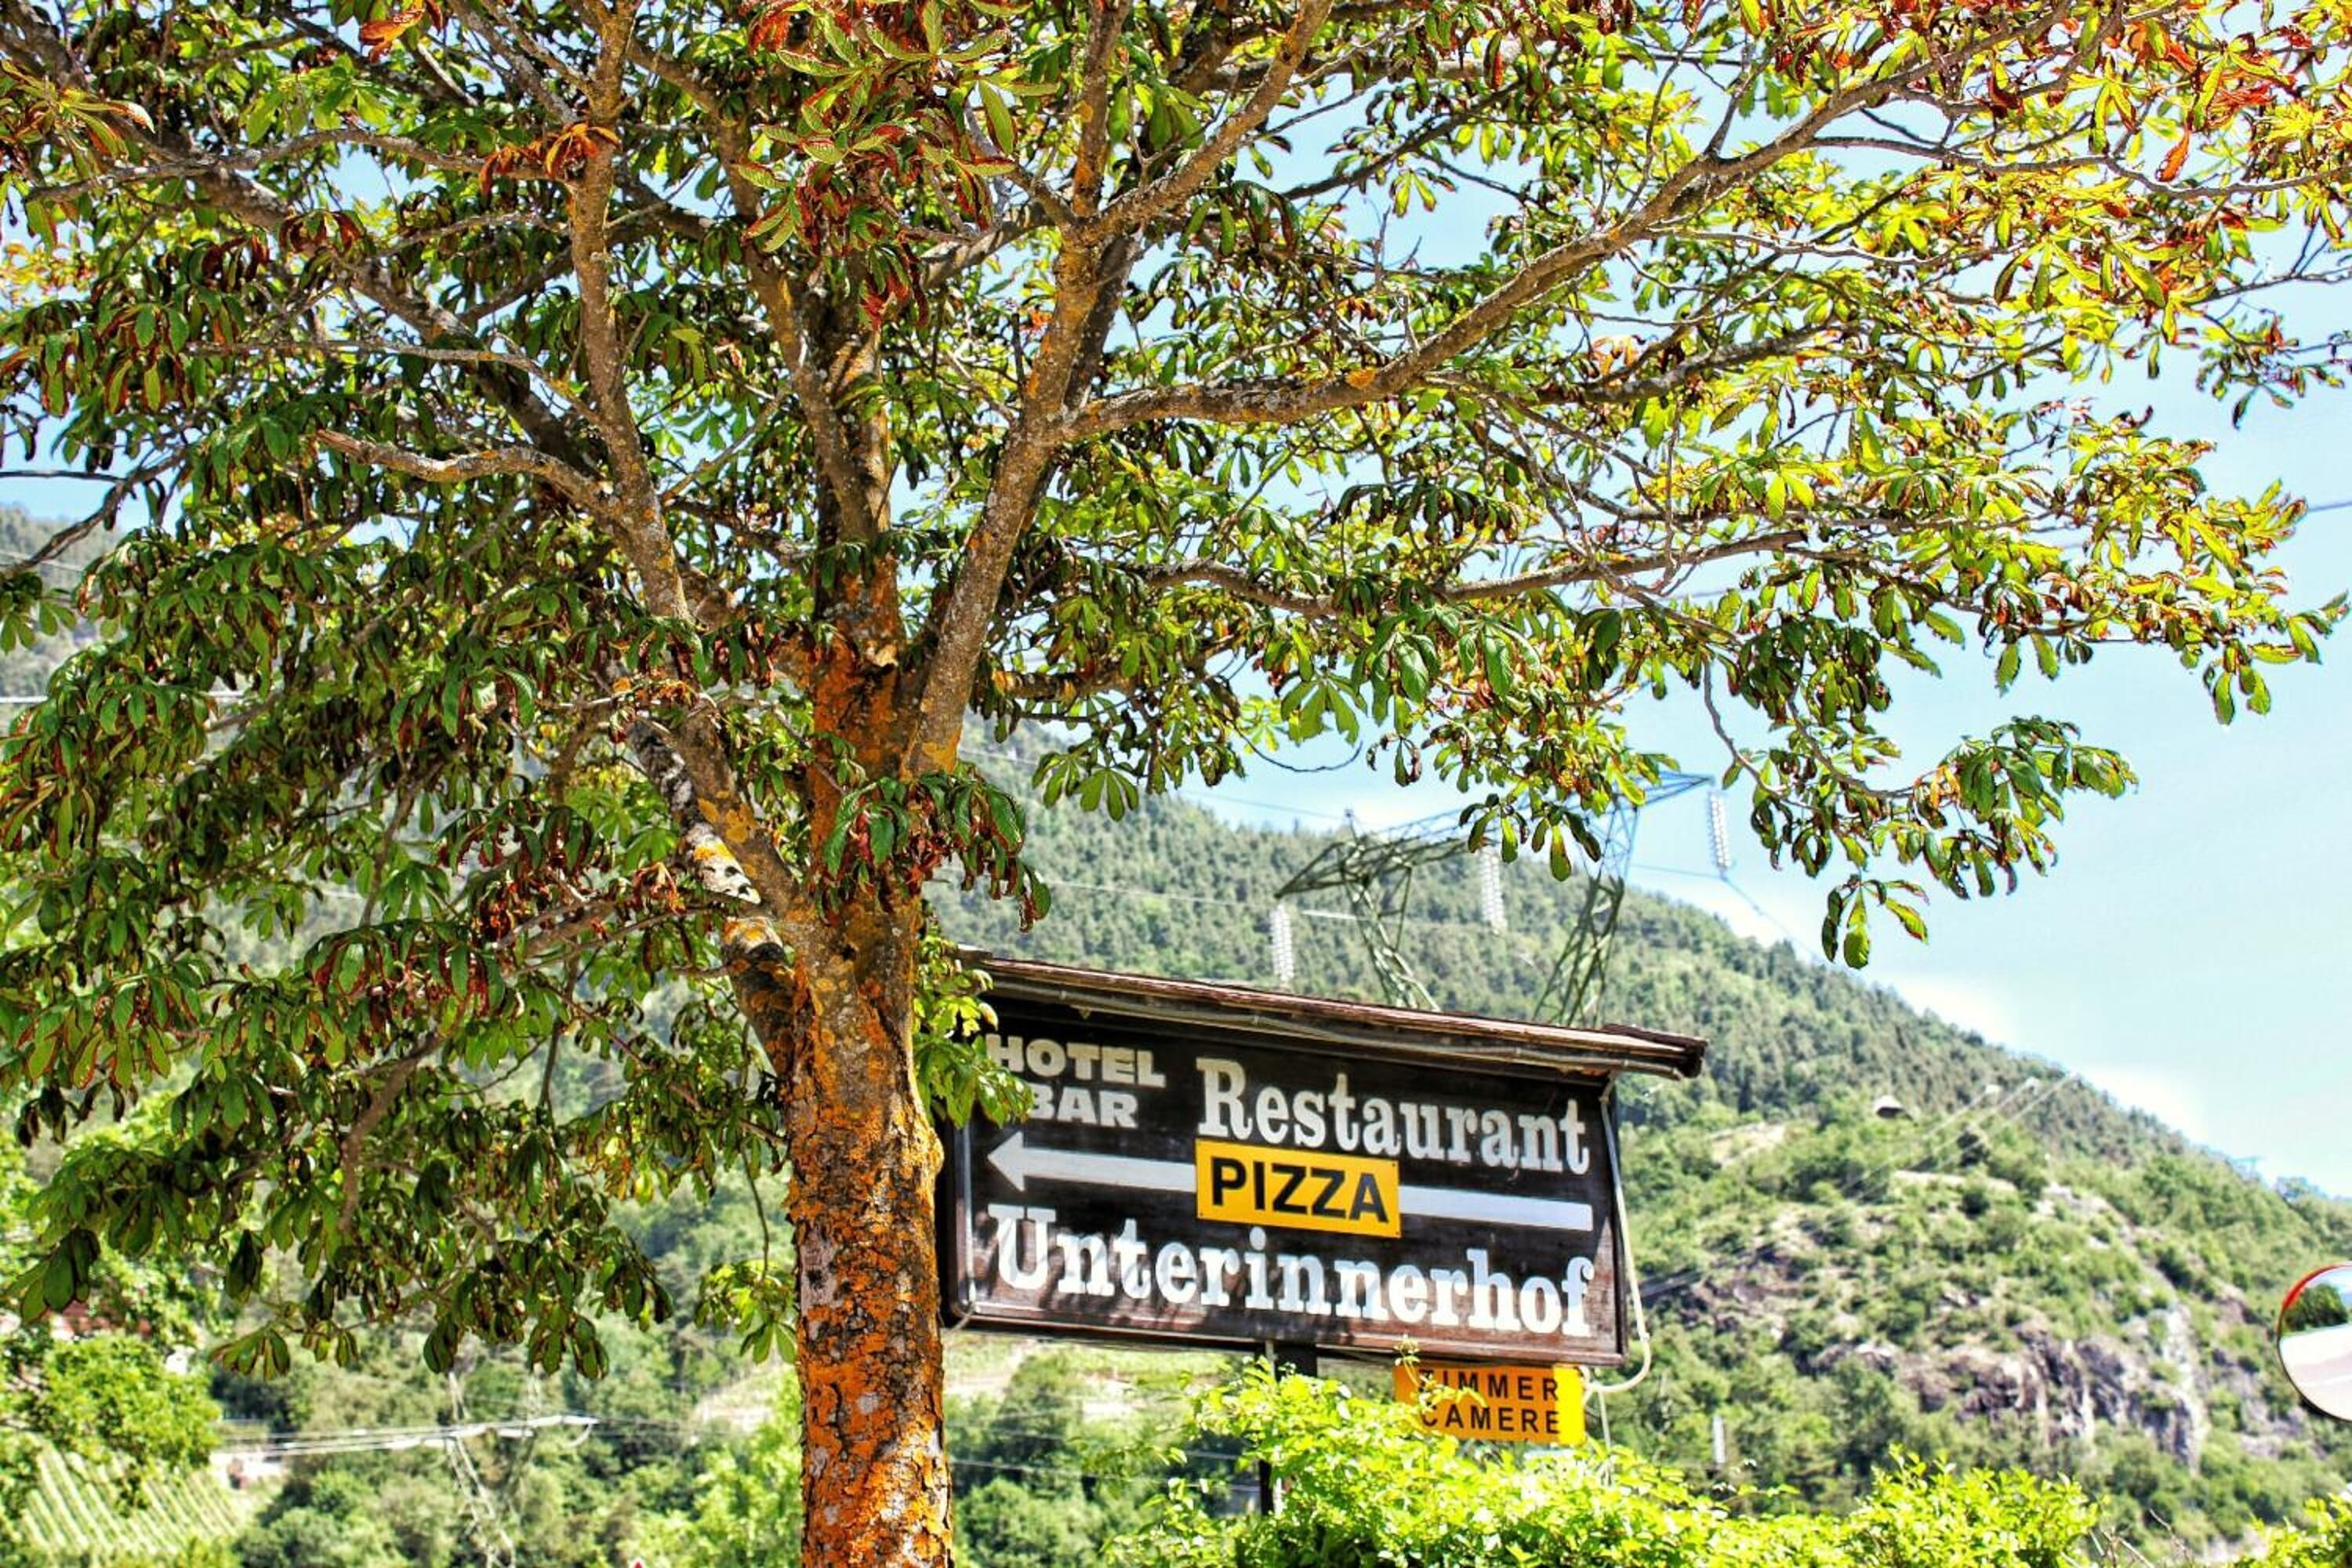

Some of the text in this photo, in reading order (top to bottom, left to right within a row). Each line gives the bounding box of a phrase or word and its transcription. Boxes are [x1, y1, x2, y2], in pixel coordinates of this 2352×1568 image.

[985, 1033, 1167, 1089] HOTEL
[1029, 1082, 1138, 1128] BAR
[1195, 1056, 1591, 1176] Restaurant
[1210, 1156, 1390, 1225] PIZZA
[987, 1203, 1595, 1338] Unterinnerhof
[1420, 1403, 1560, 1435] CAMERE
